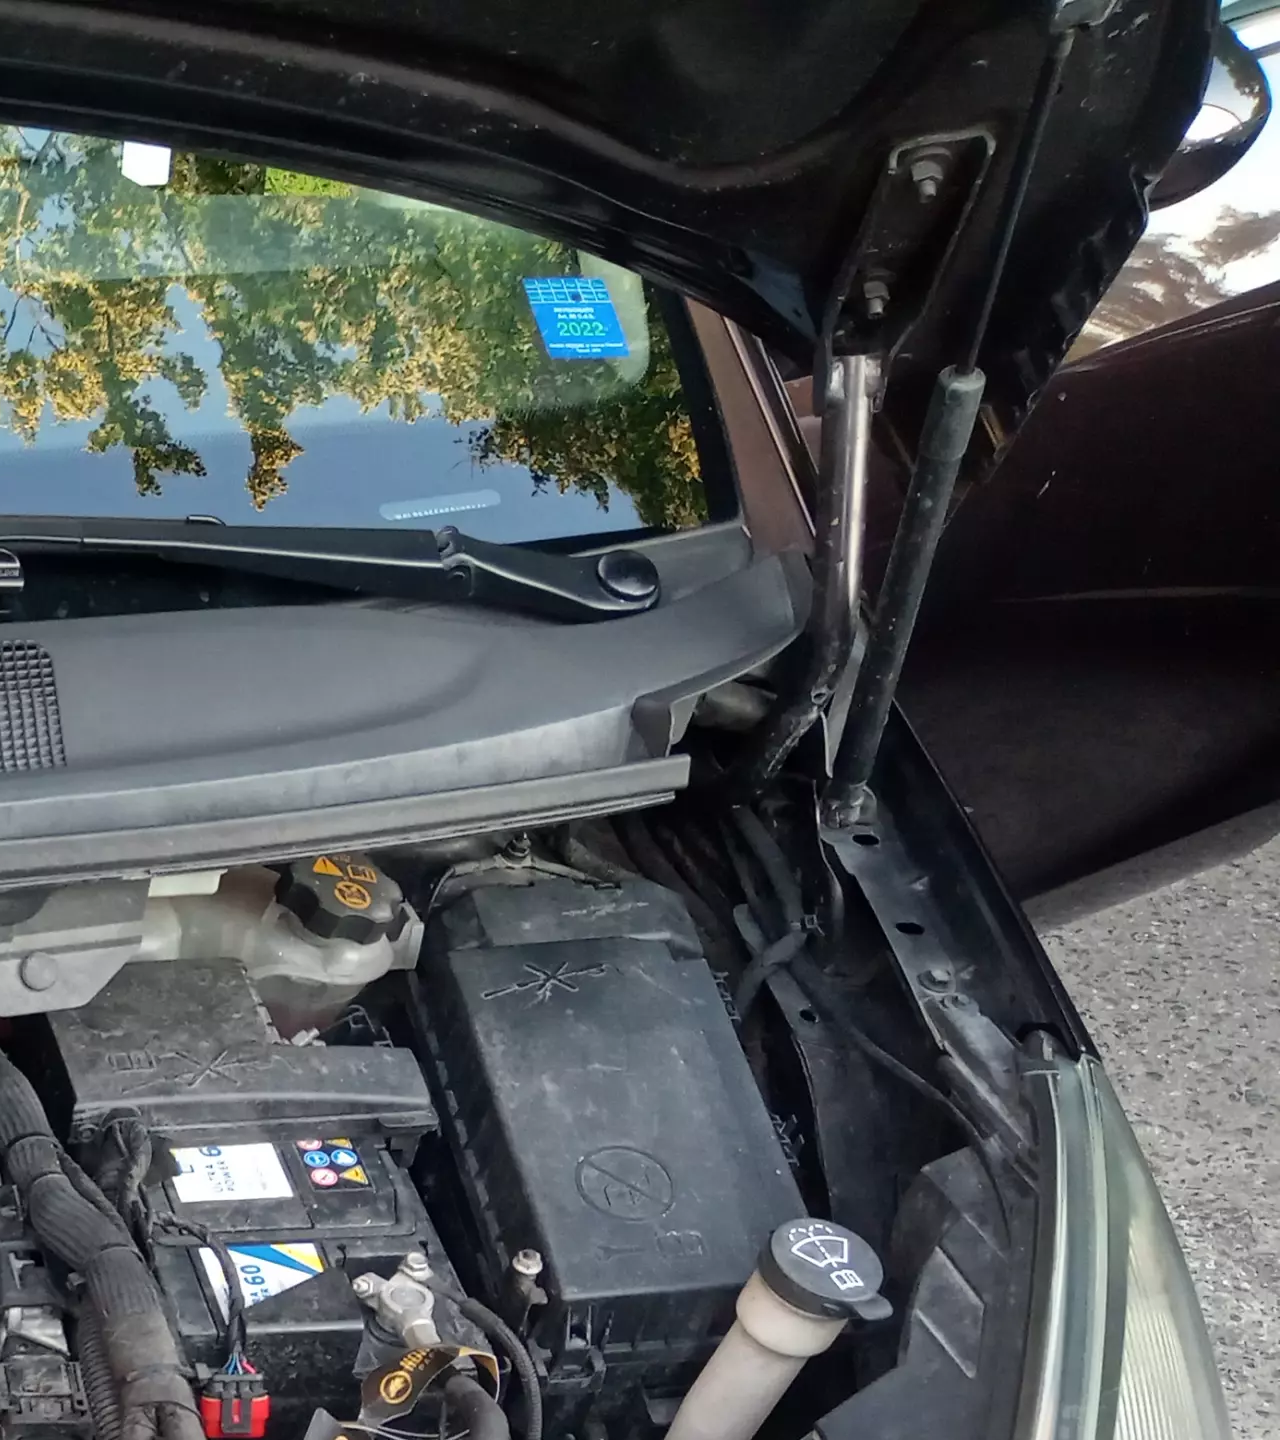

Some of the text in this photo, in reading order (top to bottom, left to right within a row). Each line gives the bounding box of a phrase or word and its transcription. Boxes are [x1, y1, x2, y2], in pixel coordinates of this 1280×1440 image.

[556, 321, 607, 337] 2022
[216, 1160, 236, 1194] POWER
[240, 1264, 266, 1286] 60
